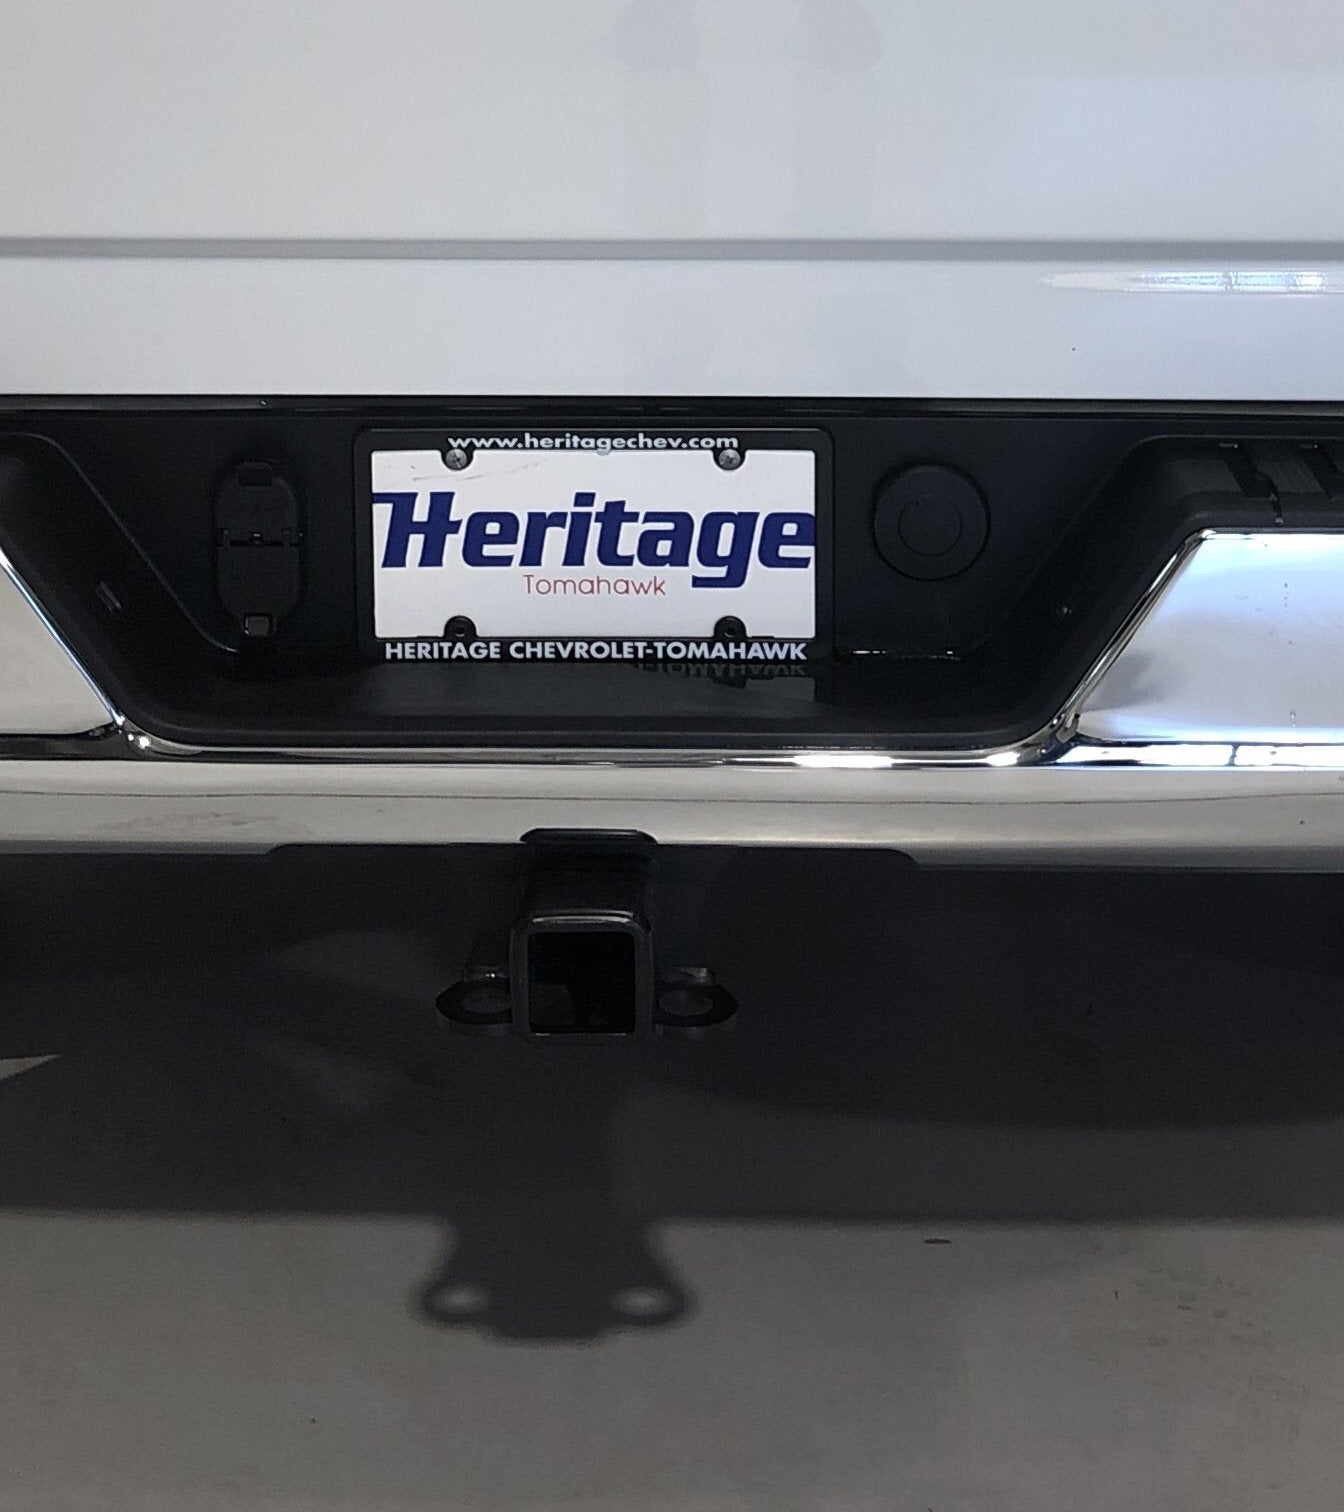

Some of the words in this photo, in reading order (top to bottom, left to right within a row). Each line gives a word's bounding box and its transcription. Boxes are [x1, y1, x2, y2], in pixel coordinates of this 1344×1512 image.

[447, 432, 739, 453] www.heritagechev.com
[371, 491, 816, 588] Heritage
[524, 574, 667, 595] Tomahawk
[385, 641, 501, 659] HERITAGE
[509, 641, 808, 660] CHEVROLET-TOMAHAWK
